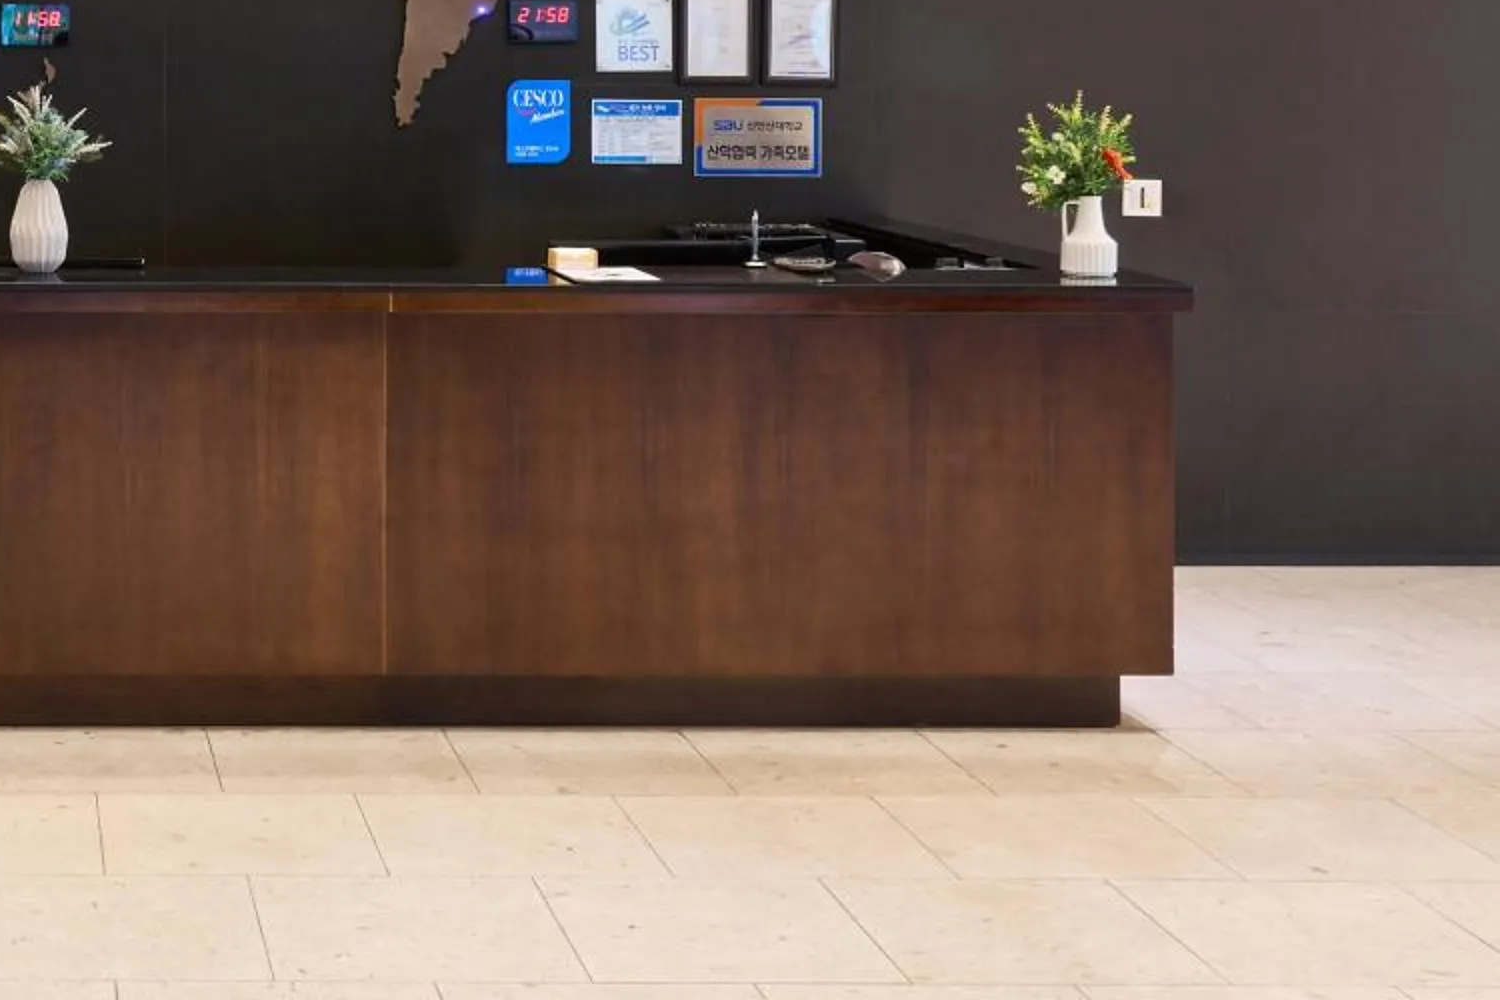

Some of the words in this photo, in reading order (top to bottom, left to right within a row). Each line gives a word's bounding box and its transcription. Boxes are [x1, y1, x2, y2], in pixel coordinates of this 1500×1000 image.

[516, 7, 570, 24] 21:58
[617, 45, 660, 62] BEST
[513, 89, 565, 108] CESCO
